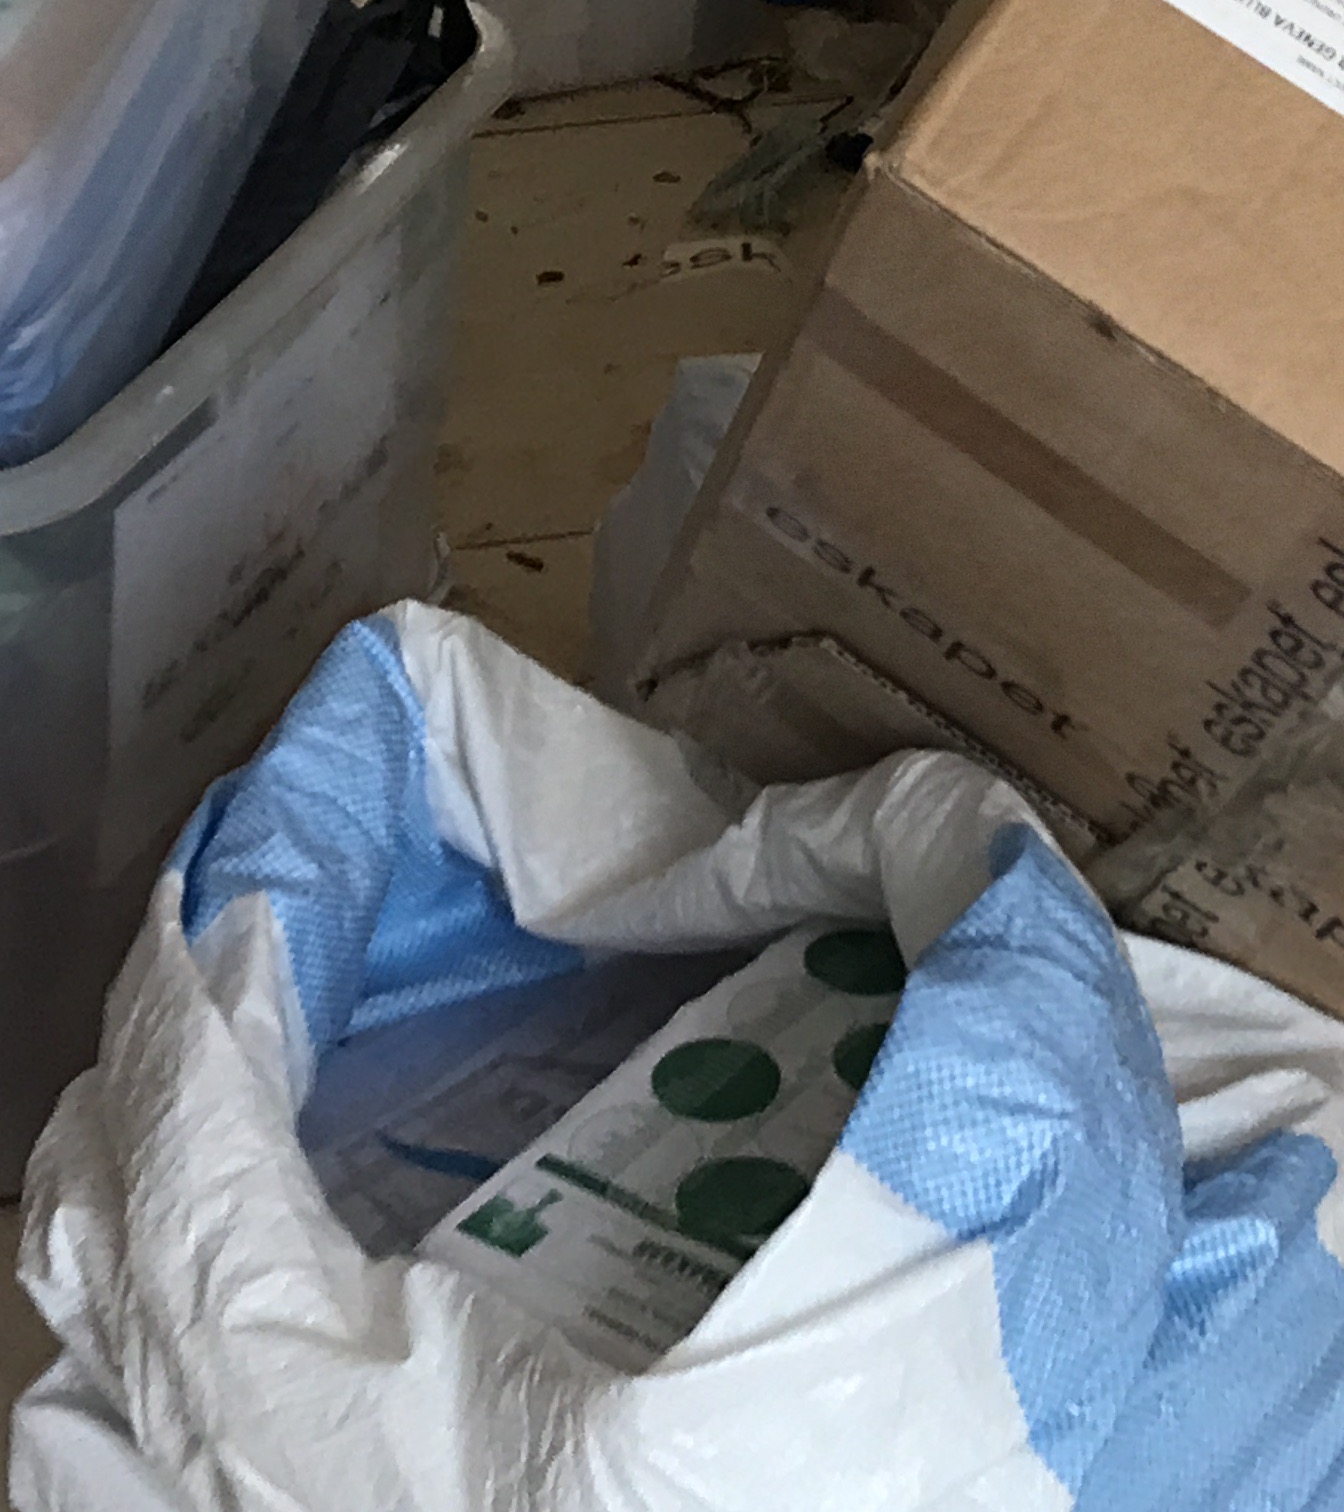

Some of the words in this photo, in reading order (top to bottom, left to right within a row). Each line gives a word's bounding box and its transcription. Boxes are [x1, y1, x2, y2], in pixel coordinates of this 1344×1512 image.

[1273, 12, 1337, 61] GENEVA
[761, 502, 1079, 744] eskapet
[1202, 600, 1334, 762] eskapet
